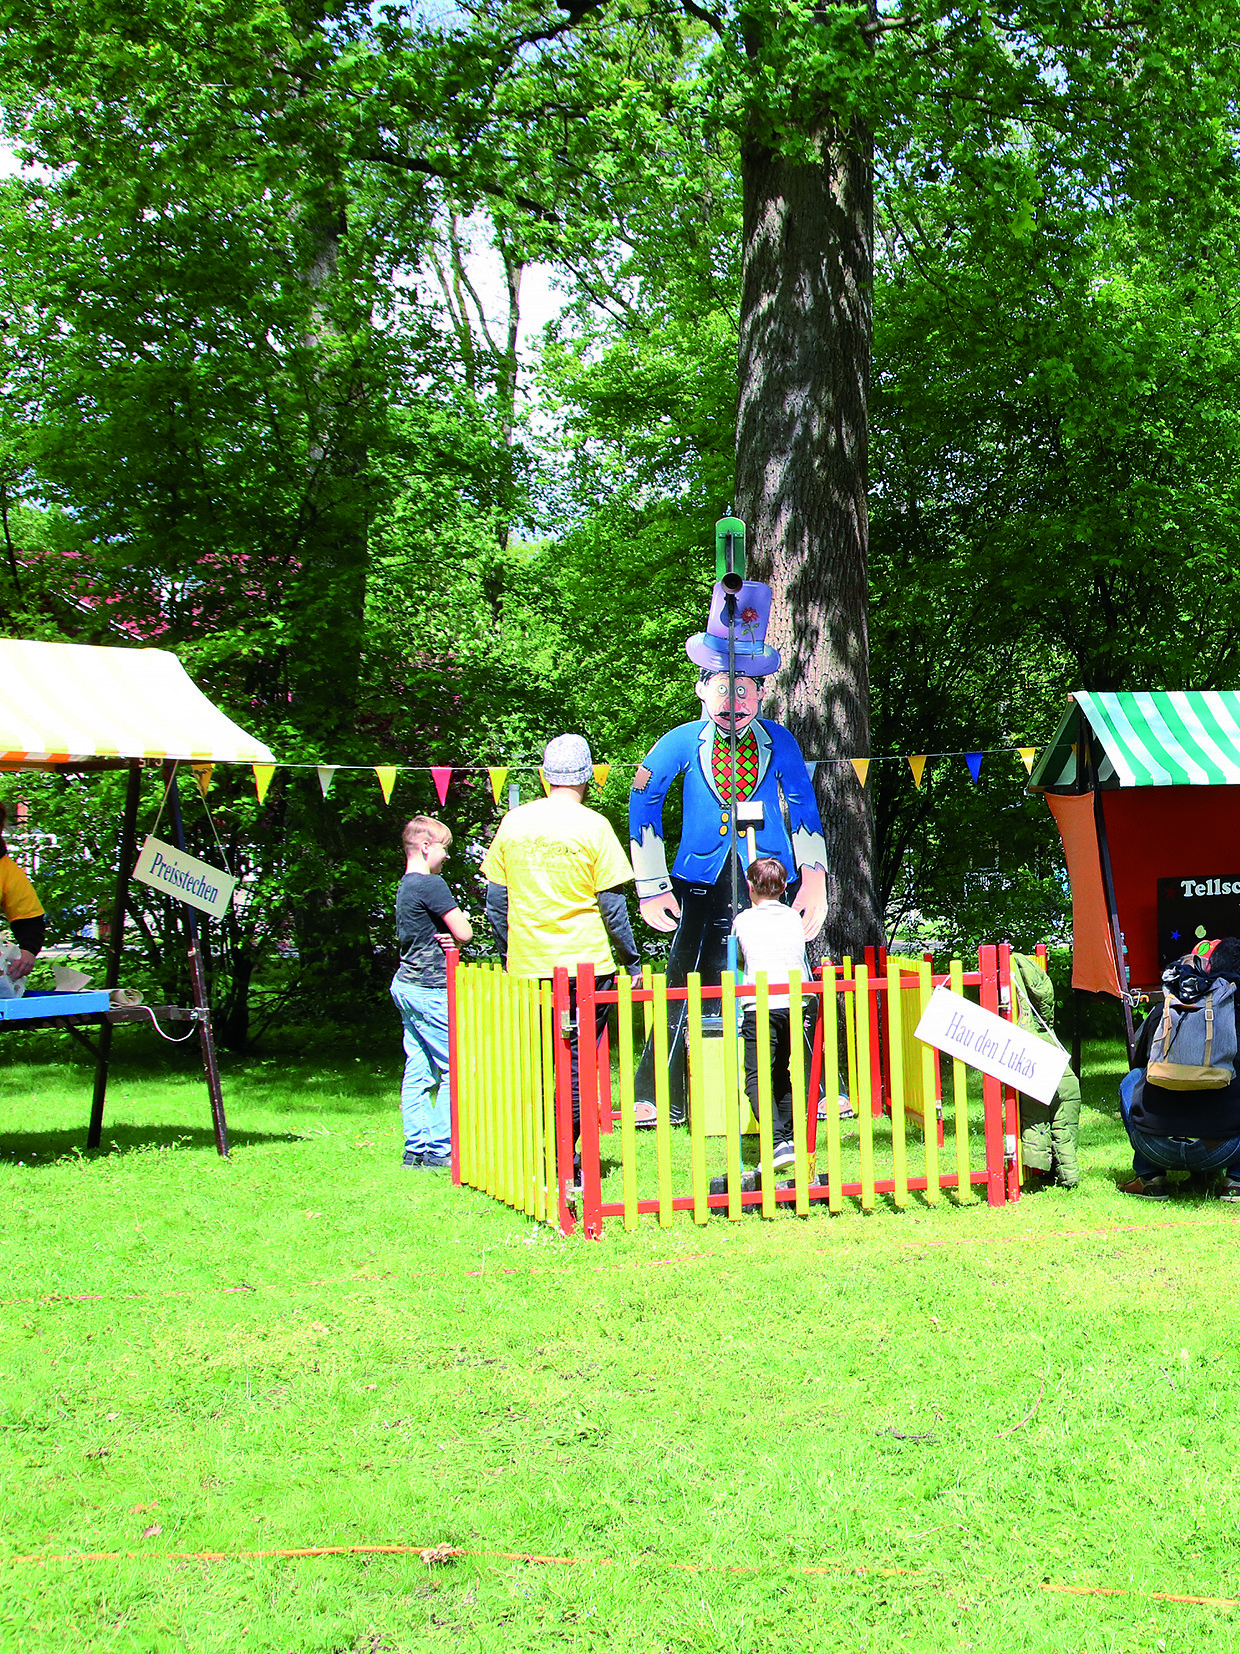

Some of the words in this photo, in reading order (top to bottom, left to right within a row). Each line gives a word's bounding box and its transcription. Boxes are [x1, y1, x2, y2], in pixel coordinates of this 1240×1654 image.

[149, 851, 219, 904] Preisstechen
[945, 1011, 975, 1048] Hau
[974, 1029, 999, 1059] den
[998, 1039, 1037, 1079] Lukas
